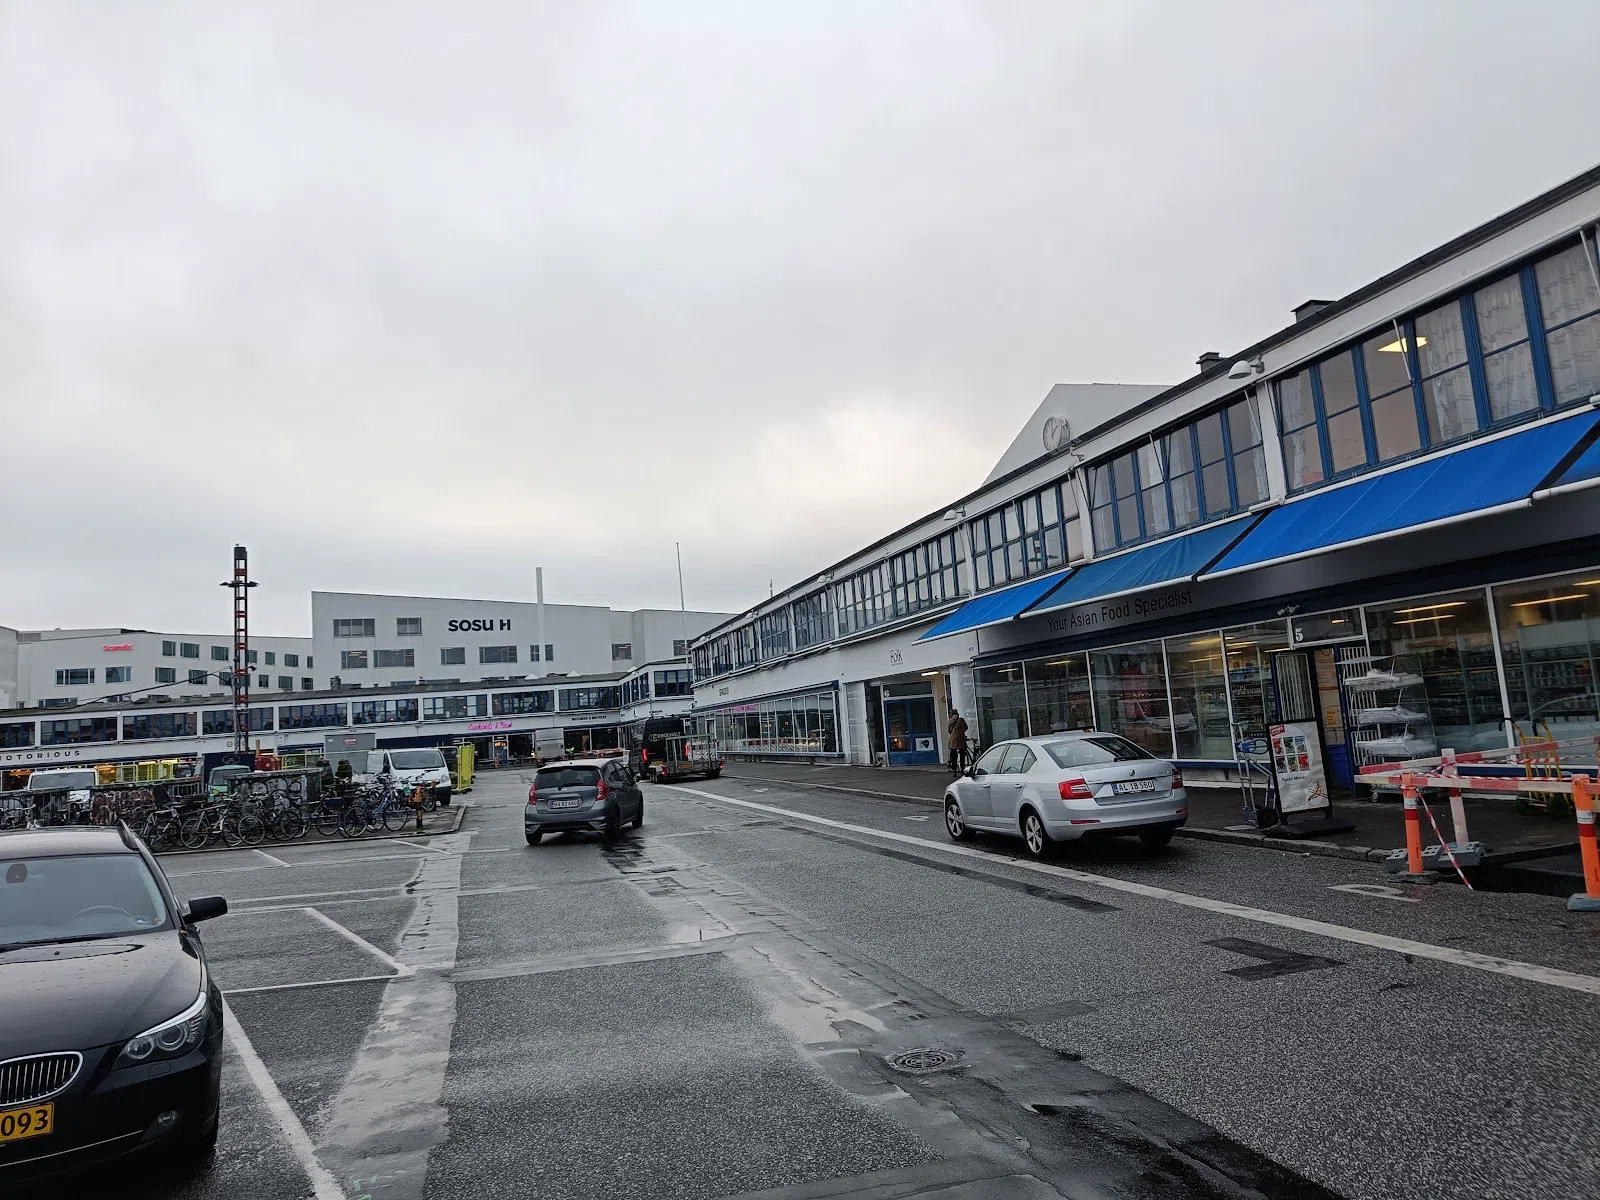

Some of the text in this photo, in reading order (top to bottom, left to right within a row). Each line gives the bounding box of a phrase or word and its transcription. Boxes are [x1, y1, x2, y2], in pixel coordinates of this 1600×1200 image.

[1048, 588, 1193, 634] Your Asian Food Specialist
[448, 618, 511, 632] SOSU H
[1295, 627, 1304, 642] 5
[1119, 783, 1128, 792] AL
[0, 1109, 49, 1138] 093
